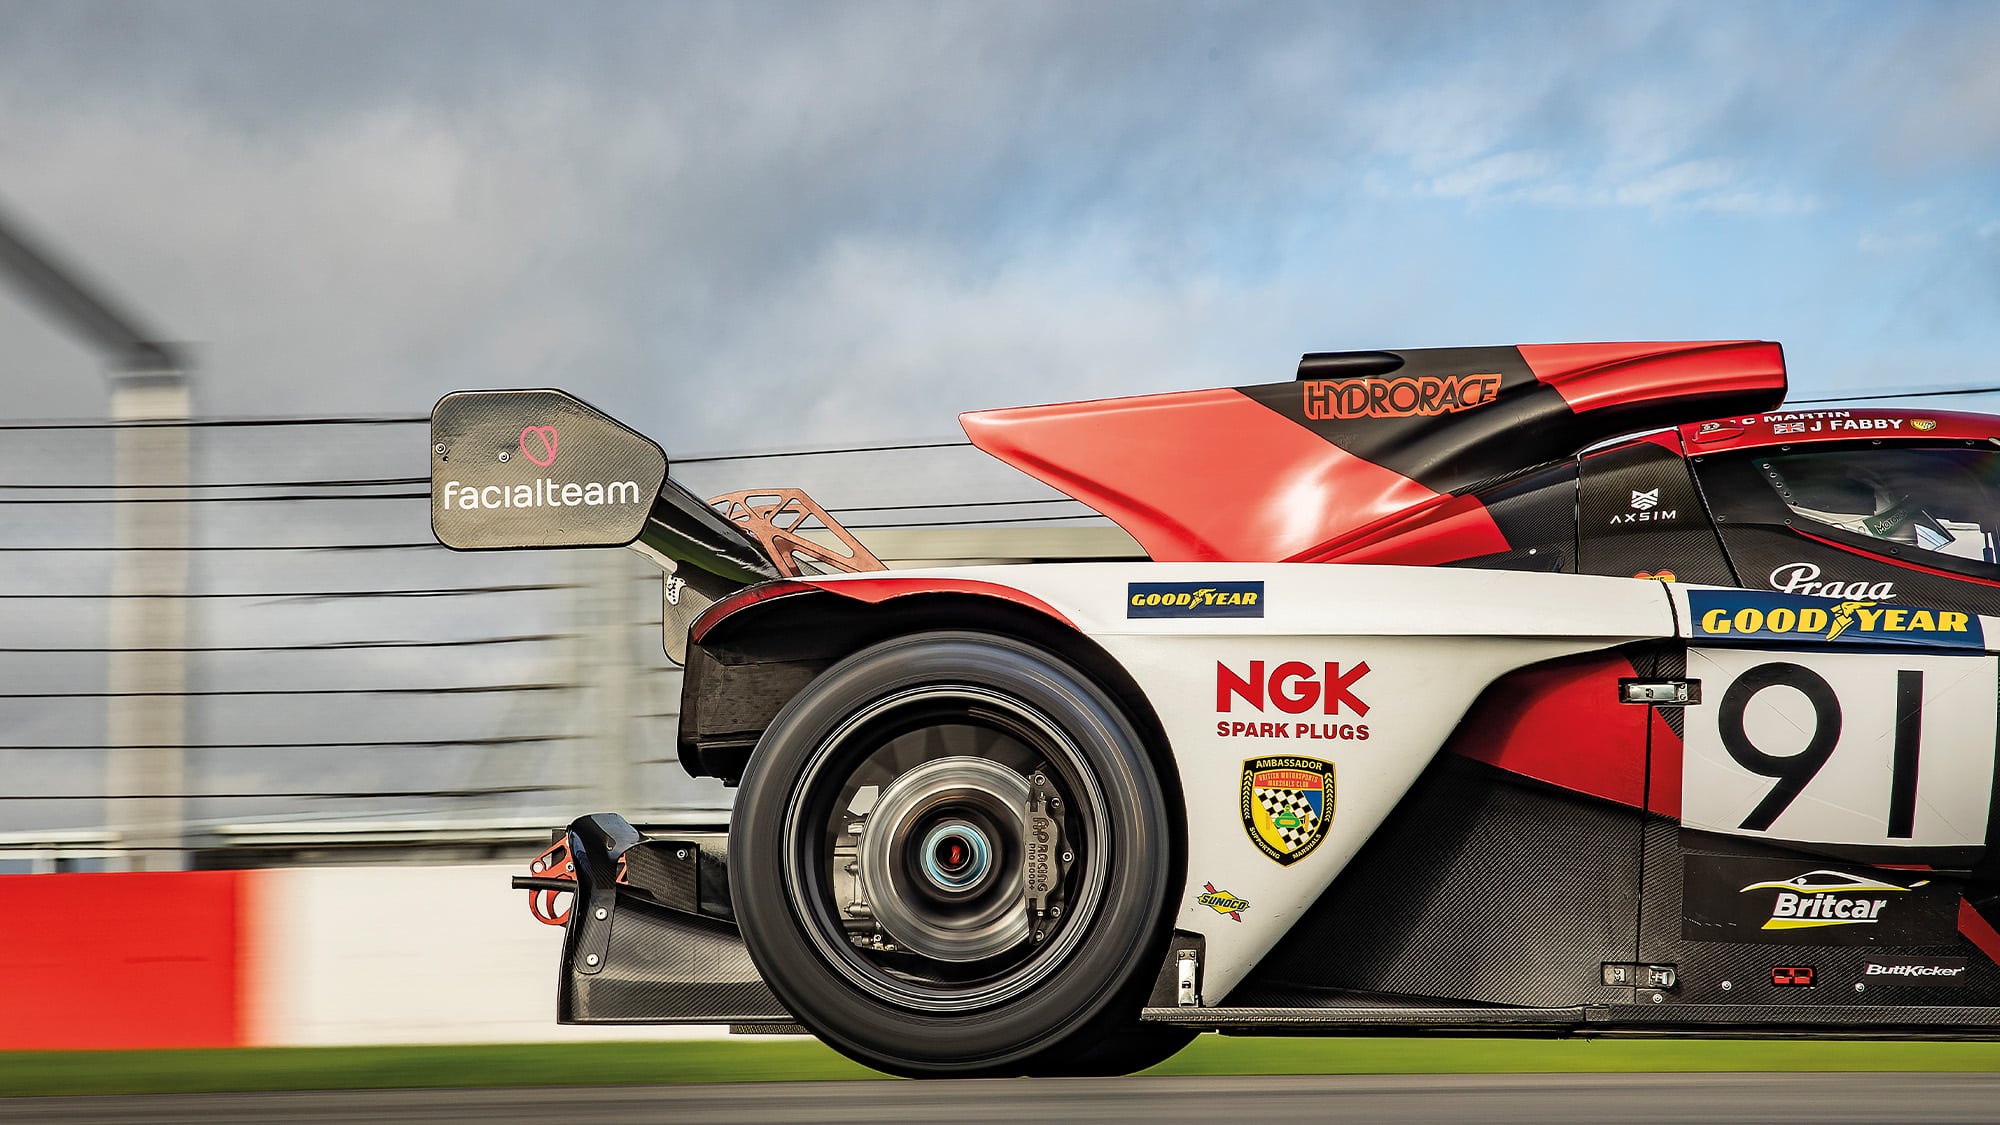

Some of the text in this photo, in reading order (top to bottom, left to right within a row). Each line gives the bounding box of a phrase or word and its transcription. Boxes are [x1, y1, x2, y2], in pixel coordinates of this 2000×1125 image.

[1304, 374, 1502, 420] HYDRORACE
[1763, 411, 1851, 423] MARTIN
[1810, 418, 1903, 432] J FABBY
[443, 478, 639, 510] facialteam
[1769, 562, 1897, 601] Praga
[1216, 659, 1371, 718] NGK
[1216, 721, 1370, 741] SPARK PLUGS
[1255, 758, 1323, 770] AMBASSADOR
[1717, 661, 1924, 839] 91
[1249, 826, 1322, 860] SUPPORTING MARSHALS
[1037, 844, 1049, 892] RACING
[1201, 895, 1246, 910] SUNOCO
[1772, 893, 1887, 918] Britcar
[1865, 964, 1965, 977] ButtKicker
